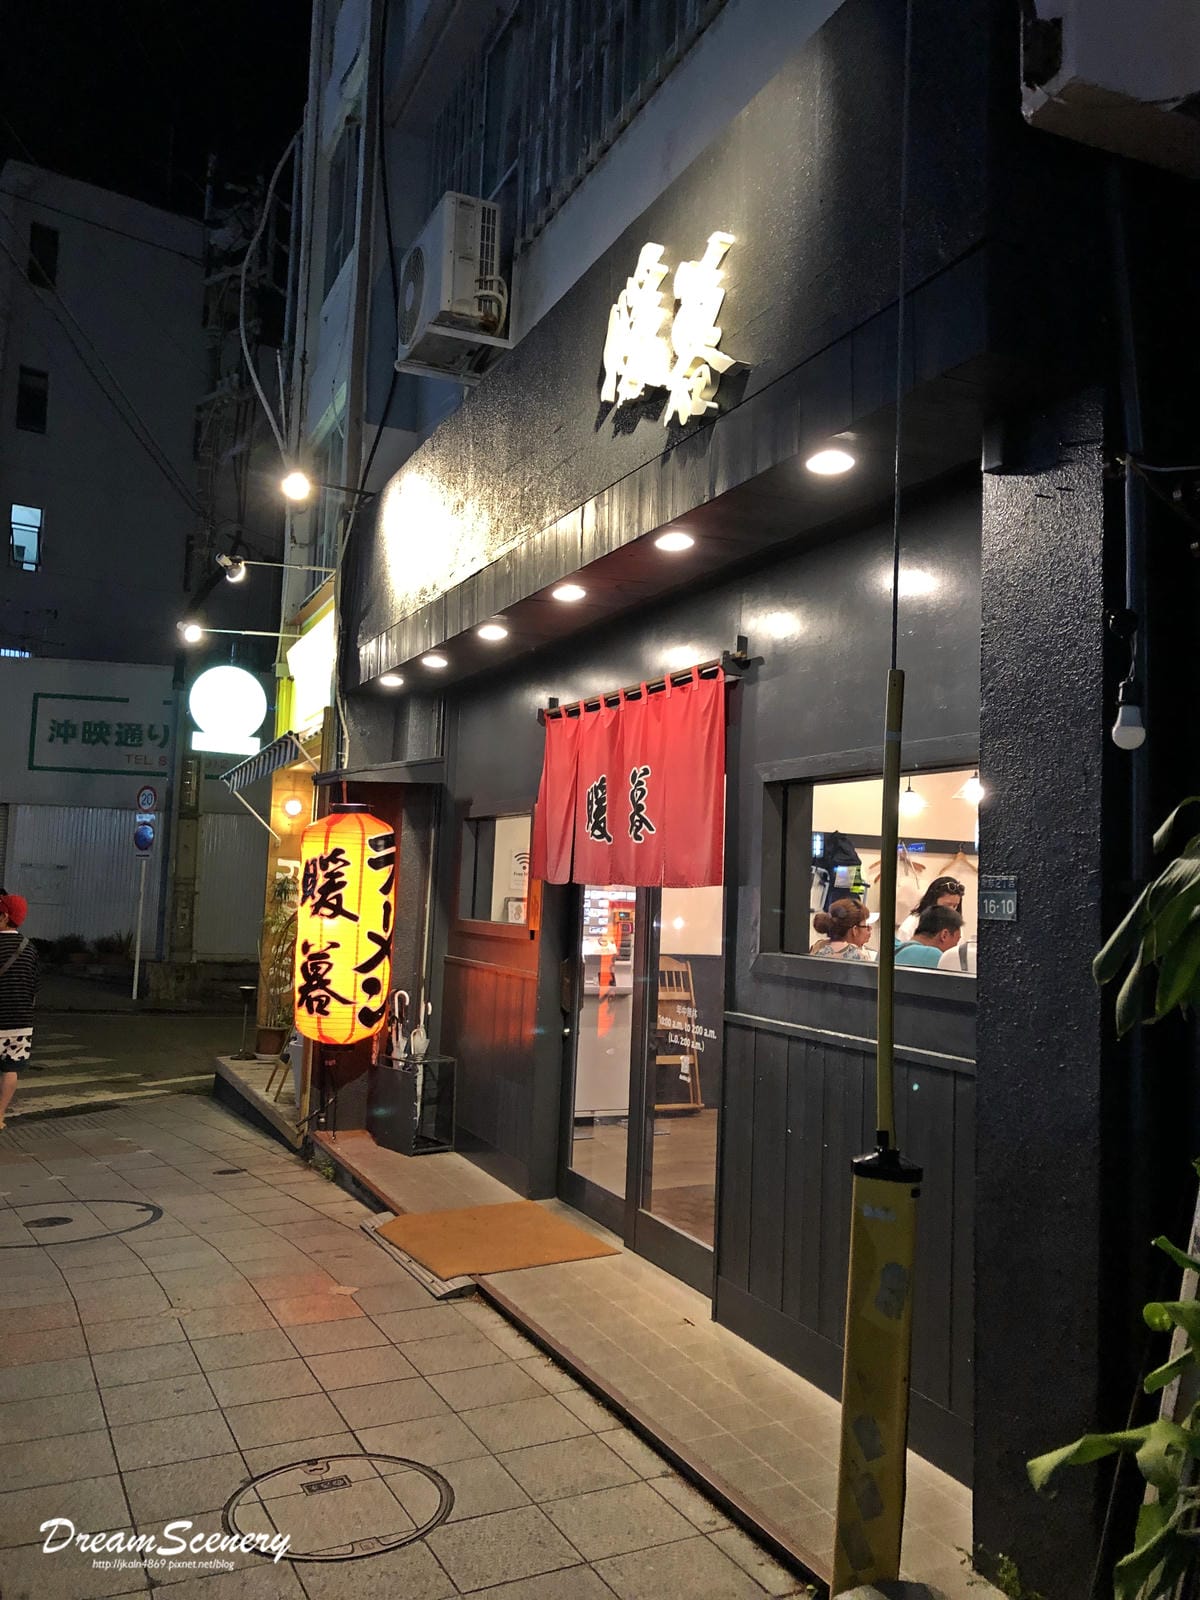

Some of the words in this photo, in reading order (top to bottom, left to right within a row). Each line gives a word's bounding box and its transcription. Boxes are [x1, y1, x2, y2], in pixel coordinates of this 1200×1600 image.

[48, 719, 169, 748] 沖映通り
[125, 753, 153, 765] TEL
[141, 792, 153, 806] 20
[298, 848, 359, 1016] 暖暮
[353, 832, 395, 1028] ラーメン
